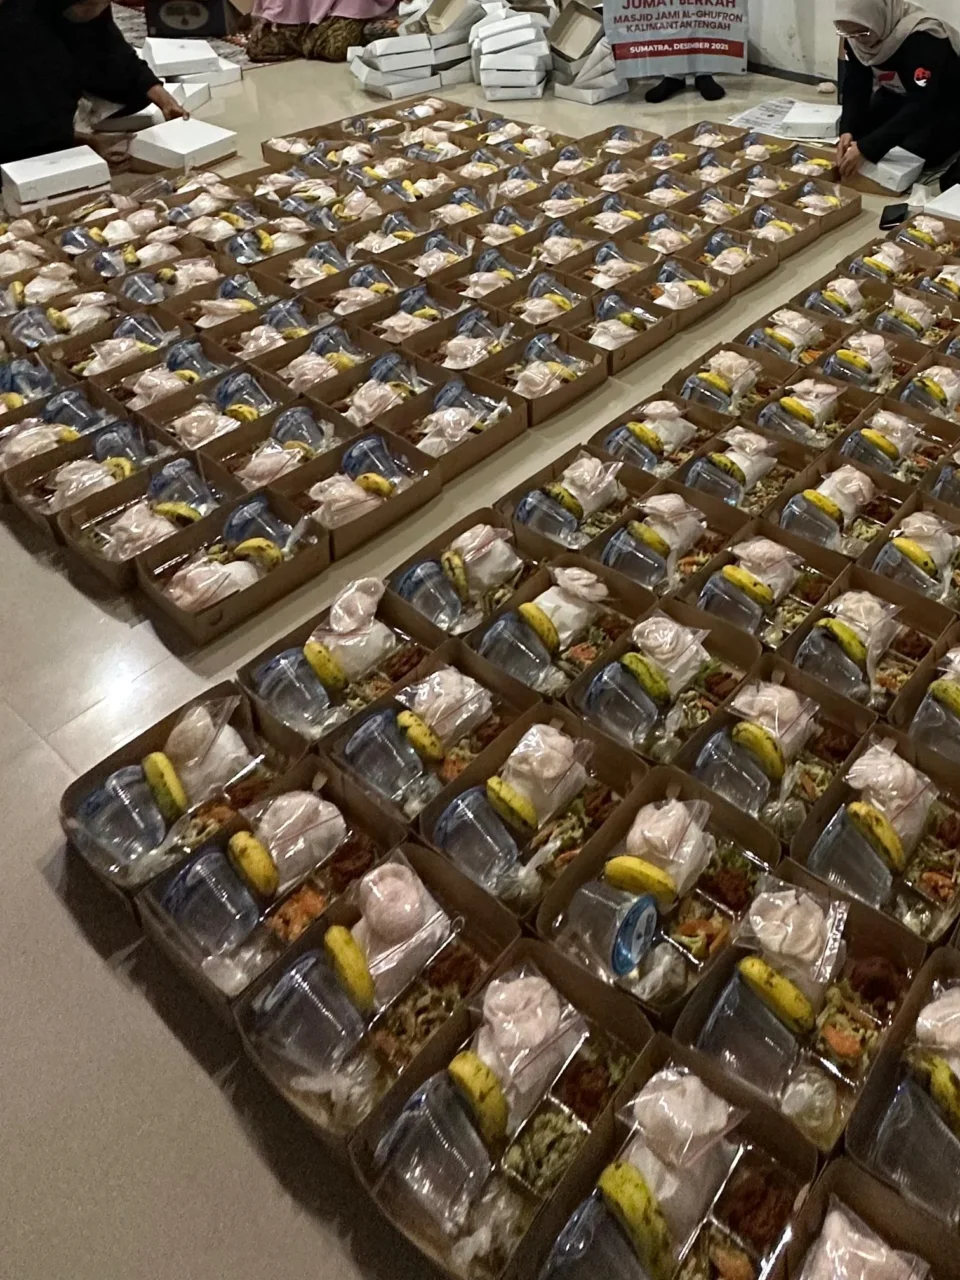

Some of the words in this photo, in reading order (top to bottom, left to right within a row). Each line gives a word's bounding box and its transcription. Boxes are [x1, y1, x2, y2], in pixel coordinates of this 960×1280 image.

[613, 14, 653, 25] MASJID
[655, 11, 680, 20] JAMI
[682, 9, 743, 23] AL-GHUFRON
[626, 20, 692, 33] KALIMANTAN
[692, 19, 731, 31] TENGAH
[629, 43, 673, 53] SUMATRA,
